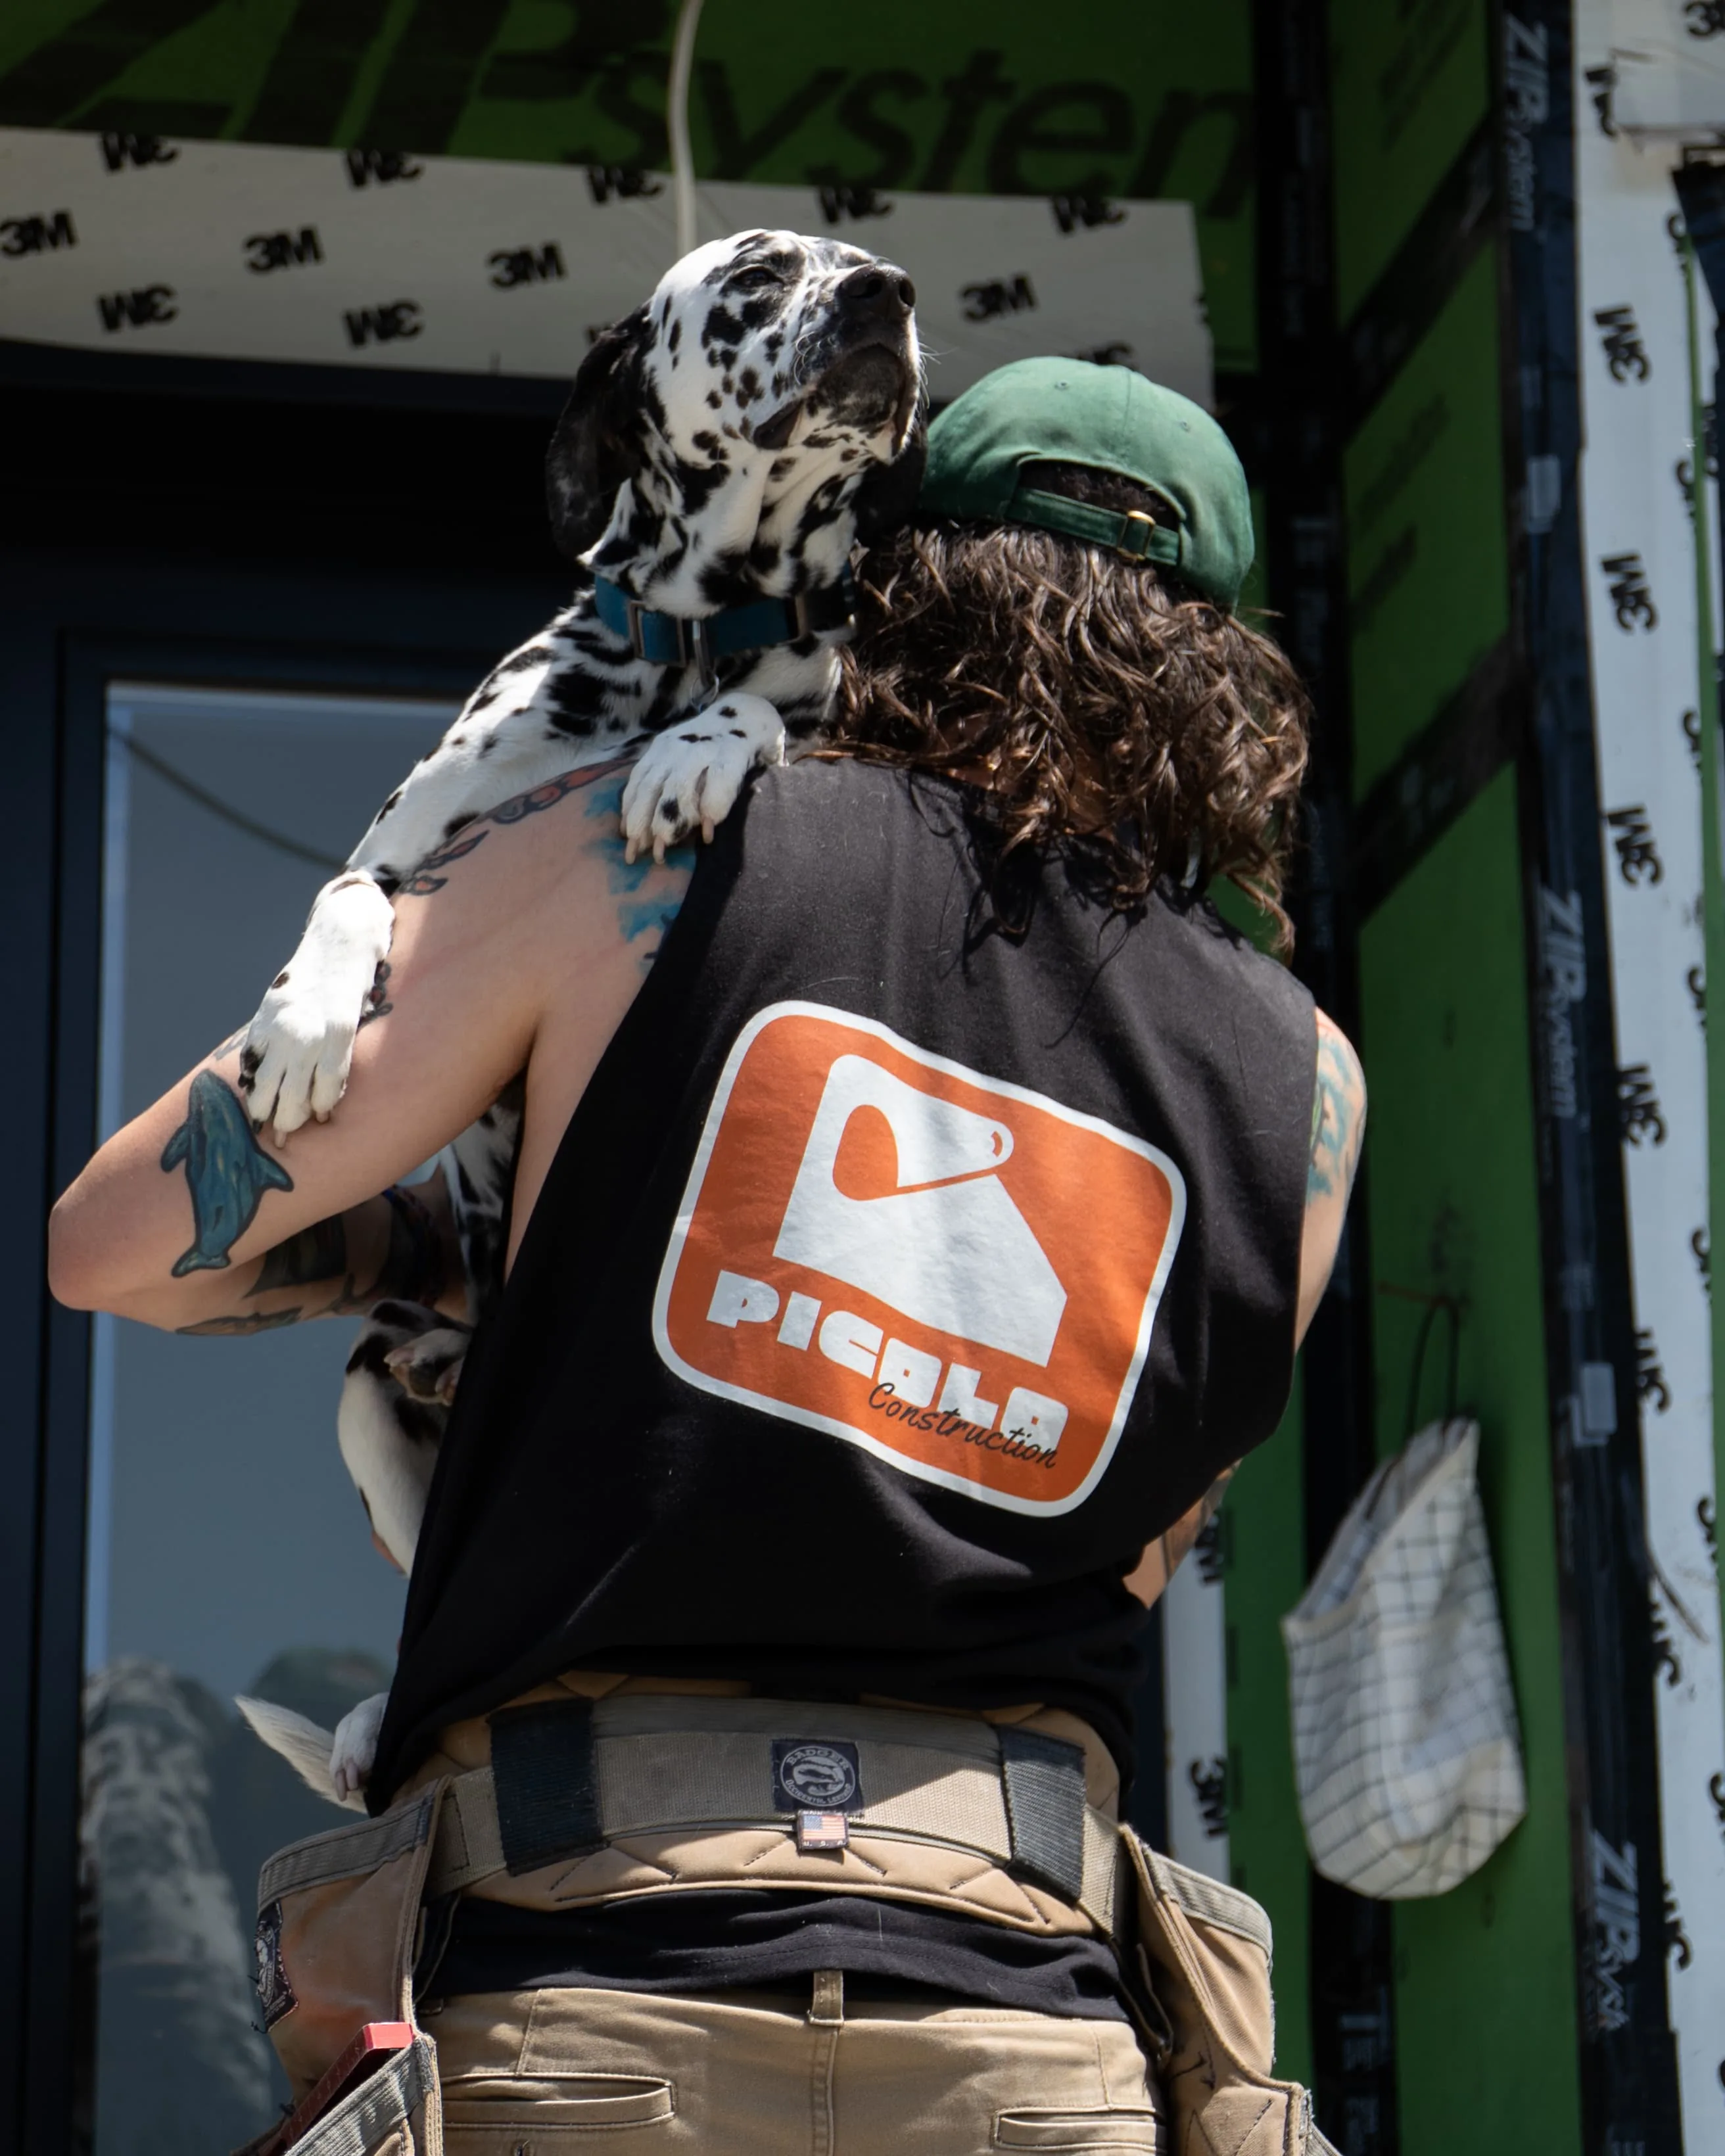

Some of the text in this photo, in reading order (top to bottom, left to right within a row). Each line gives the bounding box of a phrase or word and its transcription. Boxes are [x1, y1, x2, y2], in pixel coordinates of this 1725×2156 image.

[0, 212, 77, 257] 3M
[245, 229, 323, 273] 3M
[489, 244, 565, 288] 3M
[98, 286, 178, 332] 3M
[343, 302, 423, 348] 3M
[961, 273, 1037, 321] 3M
[1594, 305, 1651, 386] 3M
[1601, 553, 1659, 633] 3M
[1607, 807, 1663, 886] 3M
[1540, 887, 1587, 1002] ZIP
[1617, 1066, 1667, 1148] 3M
[706, 1270, 1070, 1451] PICOLO
[868, 1382, 1058, 1469] Construction
[1594, 1829, 1640, 1963] ZIP
